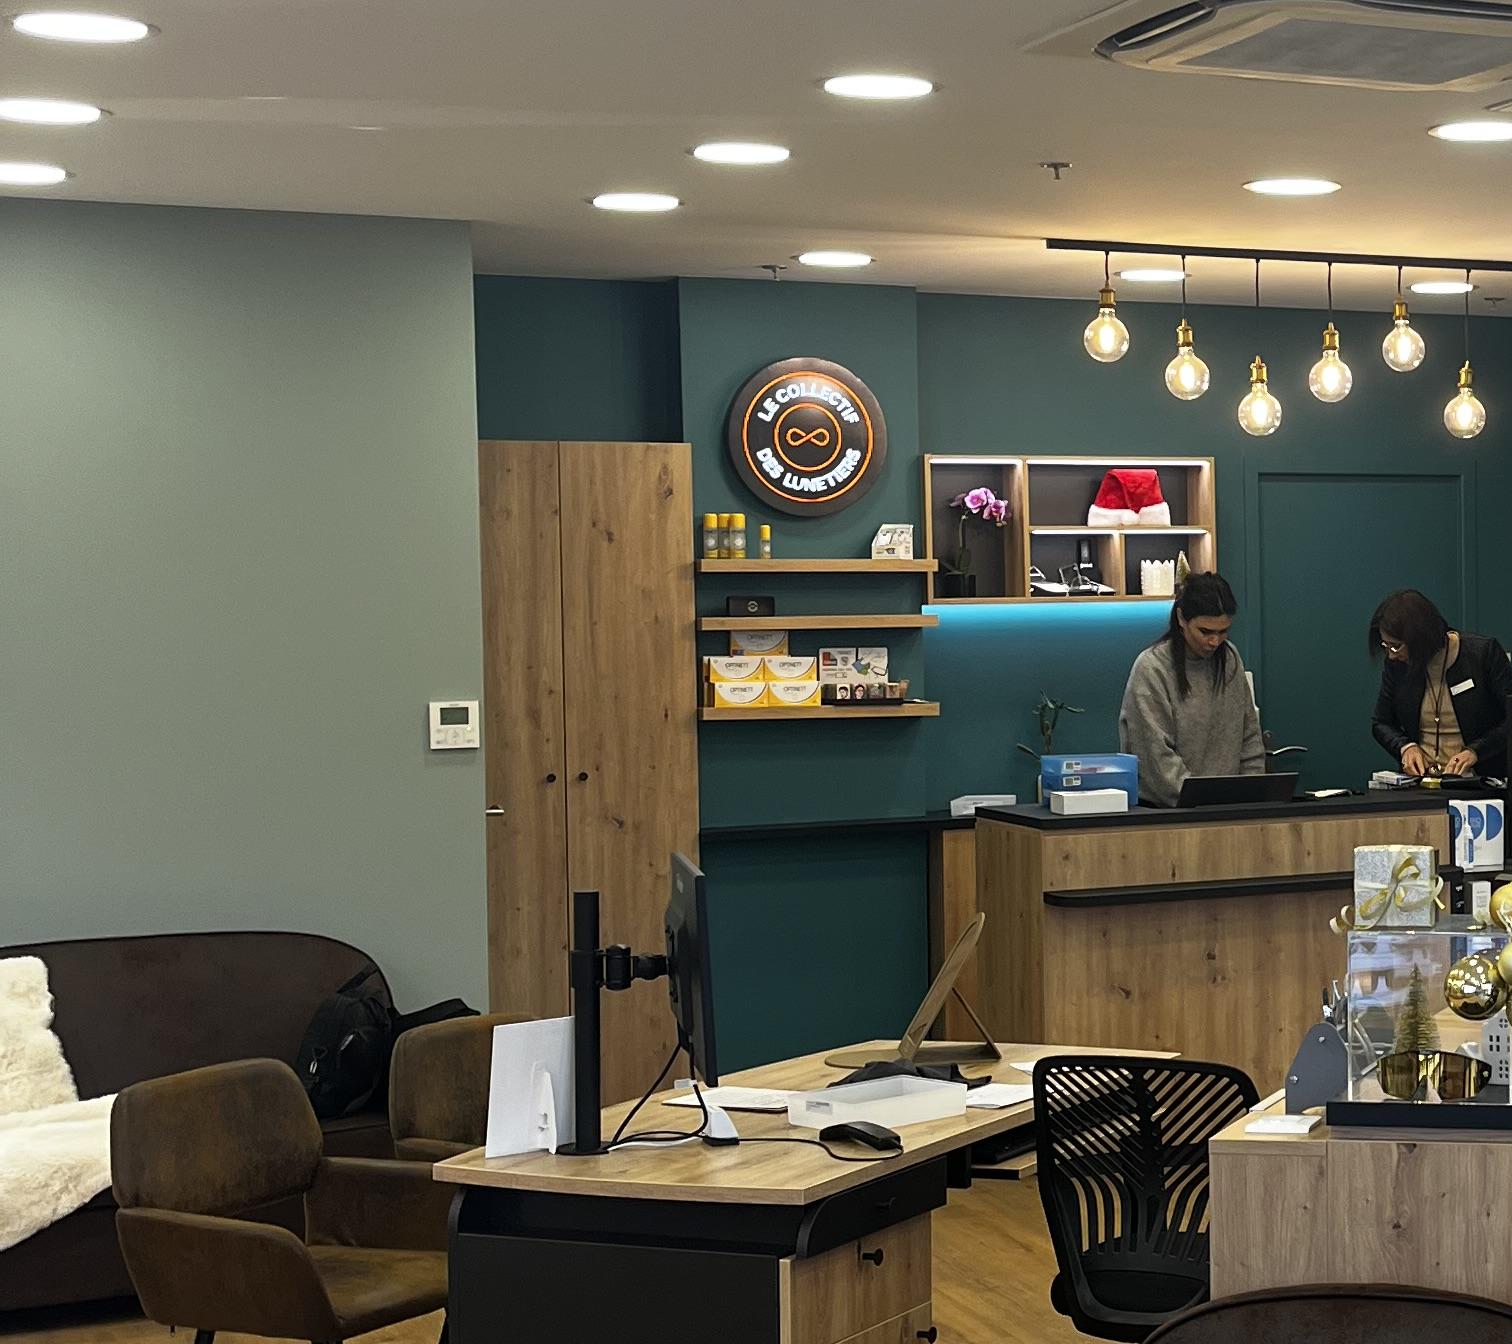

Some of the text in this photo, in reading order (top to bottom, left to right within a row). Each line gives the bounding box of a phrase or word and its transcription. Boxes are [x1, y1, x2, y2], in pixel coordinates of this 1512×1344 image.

[757, 382, 860, 424] LE COLLECTIF
[756, 447, 862, 493] DES LUNETIERS
